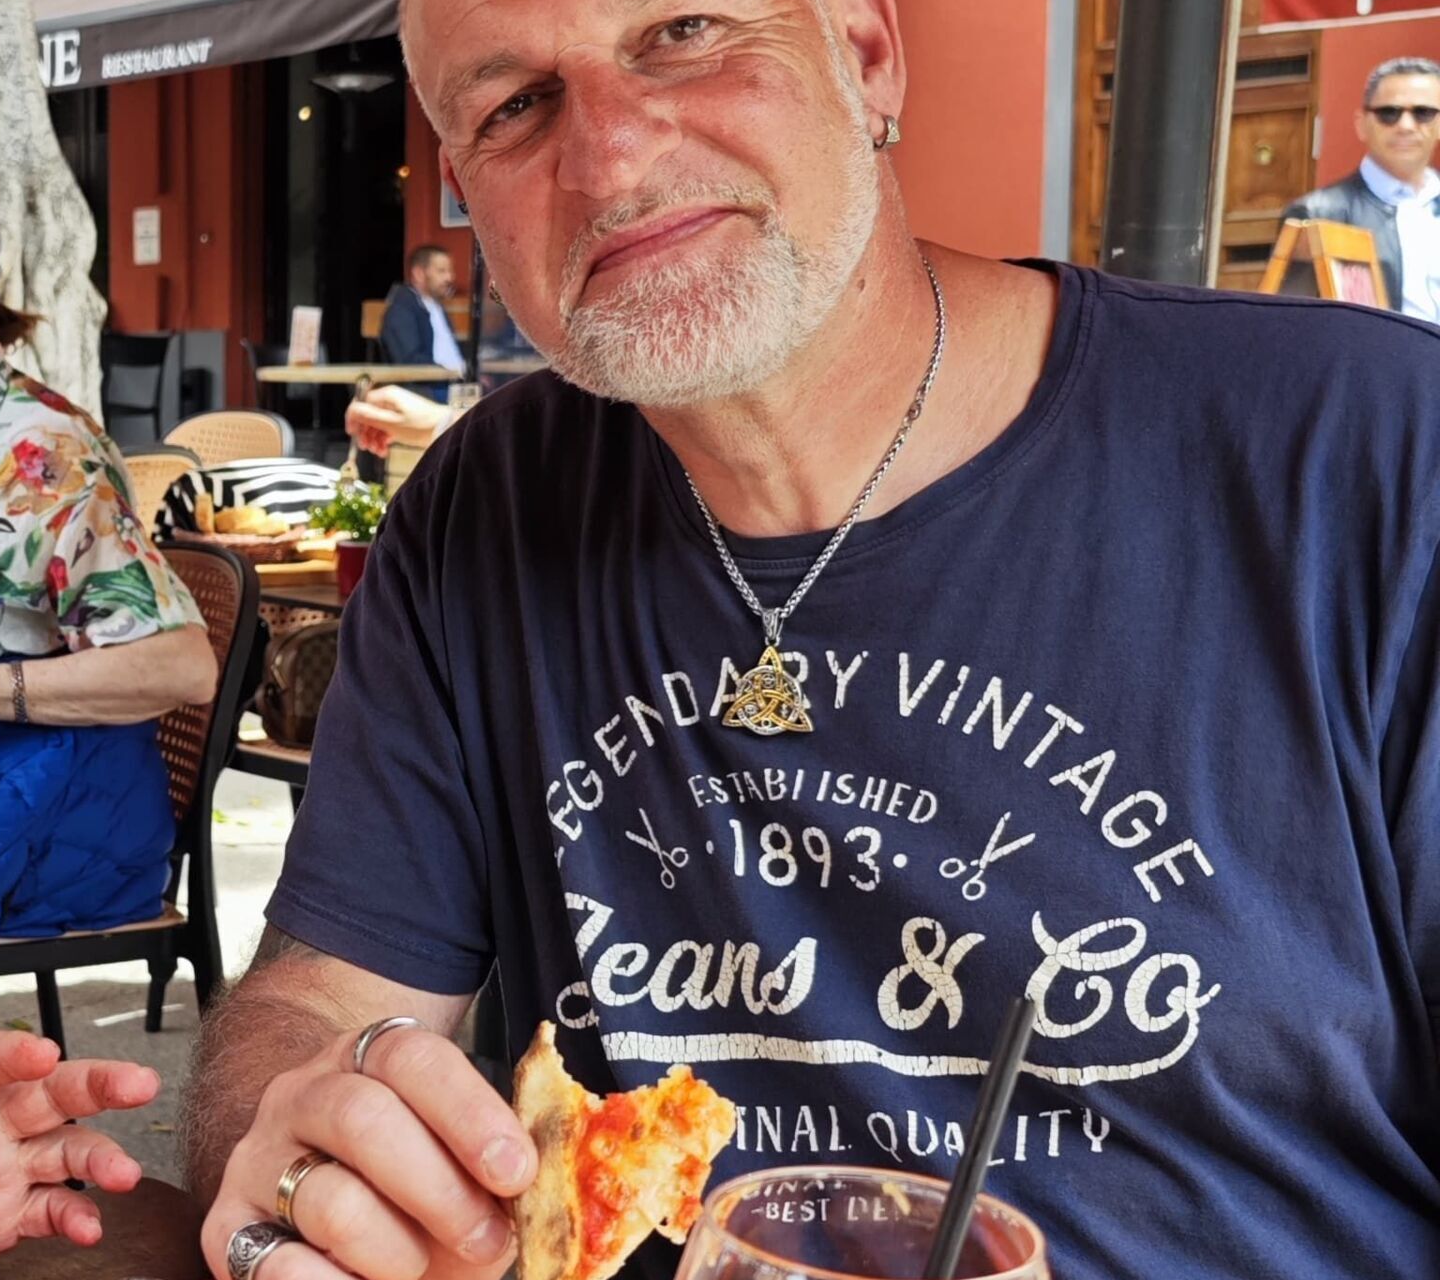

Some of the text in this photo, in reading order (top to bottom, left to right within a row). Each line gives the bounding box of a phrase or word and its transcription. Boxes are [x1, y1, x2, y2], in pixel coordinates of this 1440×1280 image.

[101, 37, 213, 79] RESTAURANT
[899, 652, 1214, 903] VINTAGE
[555, 891, 1221, 1039] Jeans & Co
[736, 1105, 850, 1153] INAL
